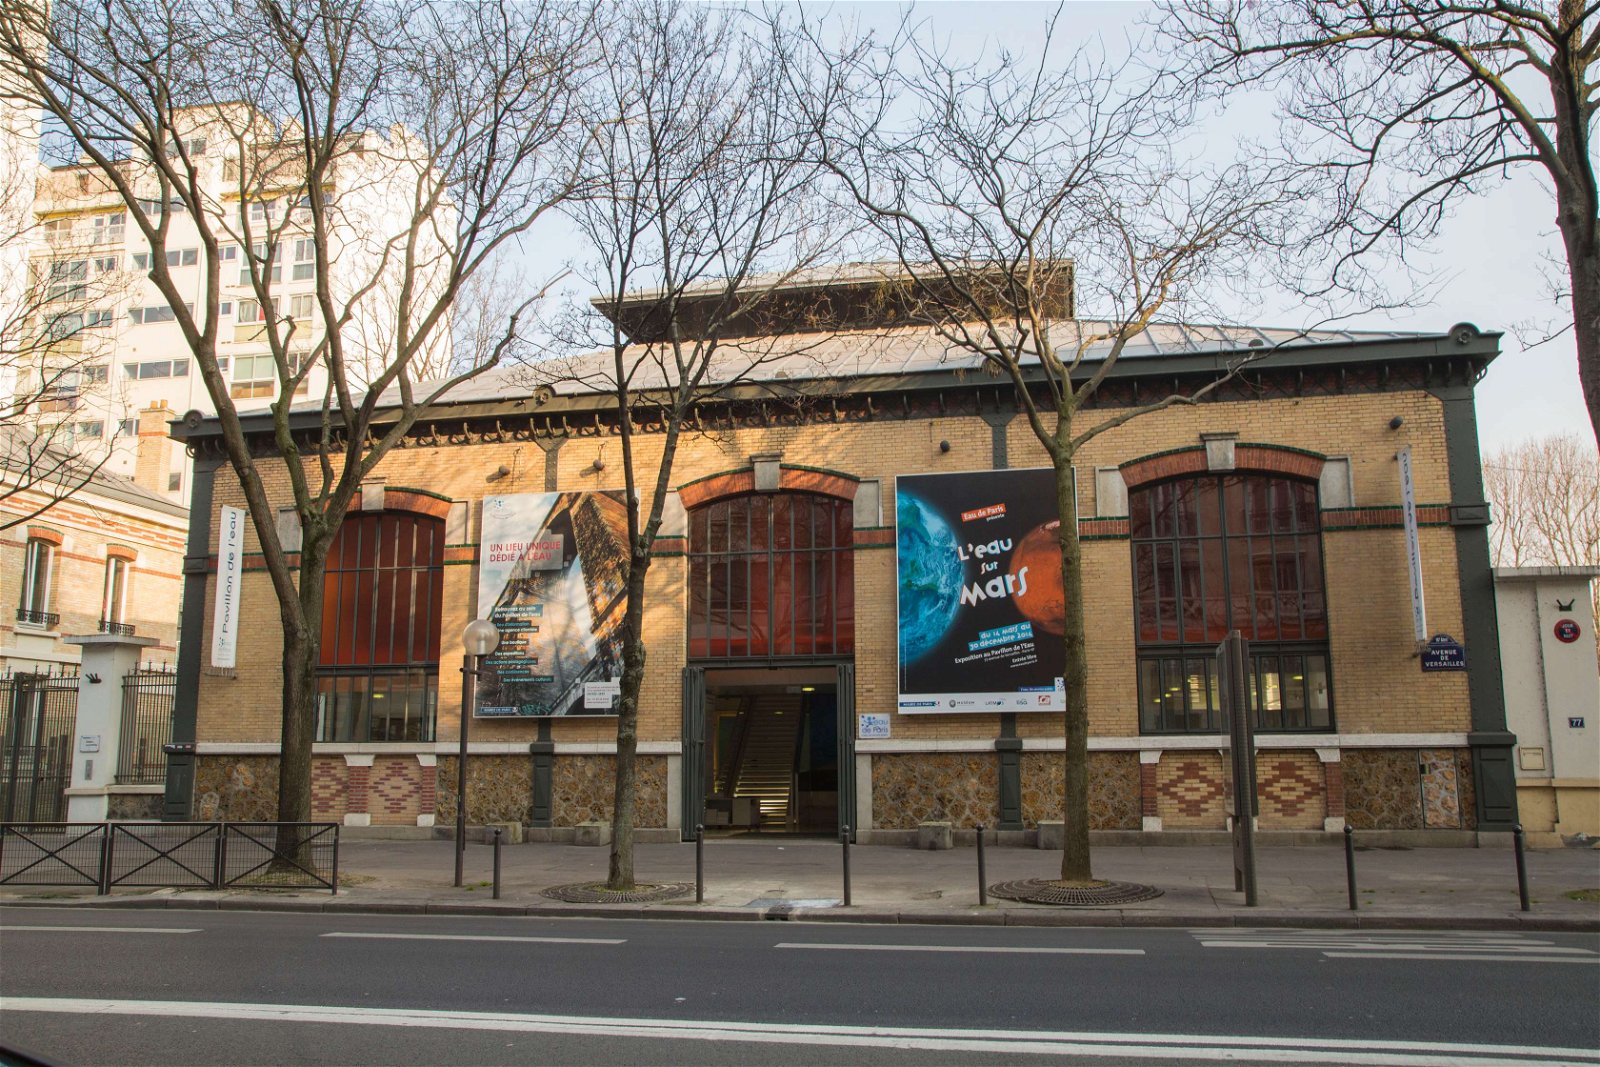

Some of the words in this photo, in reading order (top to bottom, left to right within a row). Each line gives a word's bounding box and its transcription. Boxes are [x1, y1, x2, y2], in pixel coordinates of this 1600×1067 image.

[978, 509, 986, 517] de
[987, 505, 1004, 514] Paris
[228, 512, 237, 546] l'eau
[490, 544, 503, 552] UN
[506, 543, 523, 551] LIEU
[526, 541, 560, 551] UNIQUE
[958, 538, 1012, 560] L'eau
[227, 552, 234, 570] de
[528, 552, 552, 560] L'EAU
[981, 561, 998, 575] sur
[960, 566, 1028, 607] Mars
[222, 576, 233, 634] Pavillon
[1002, 625, 1018, 634] mars
[980, 635, 1015, 646] décembre
[954, 654, 982, 664] Exposition
